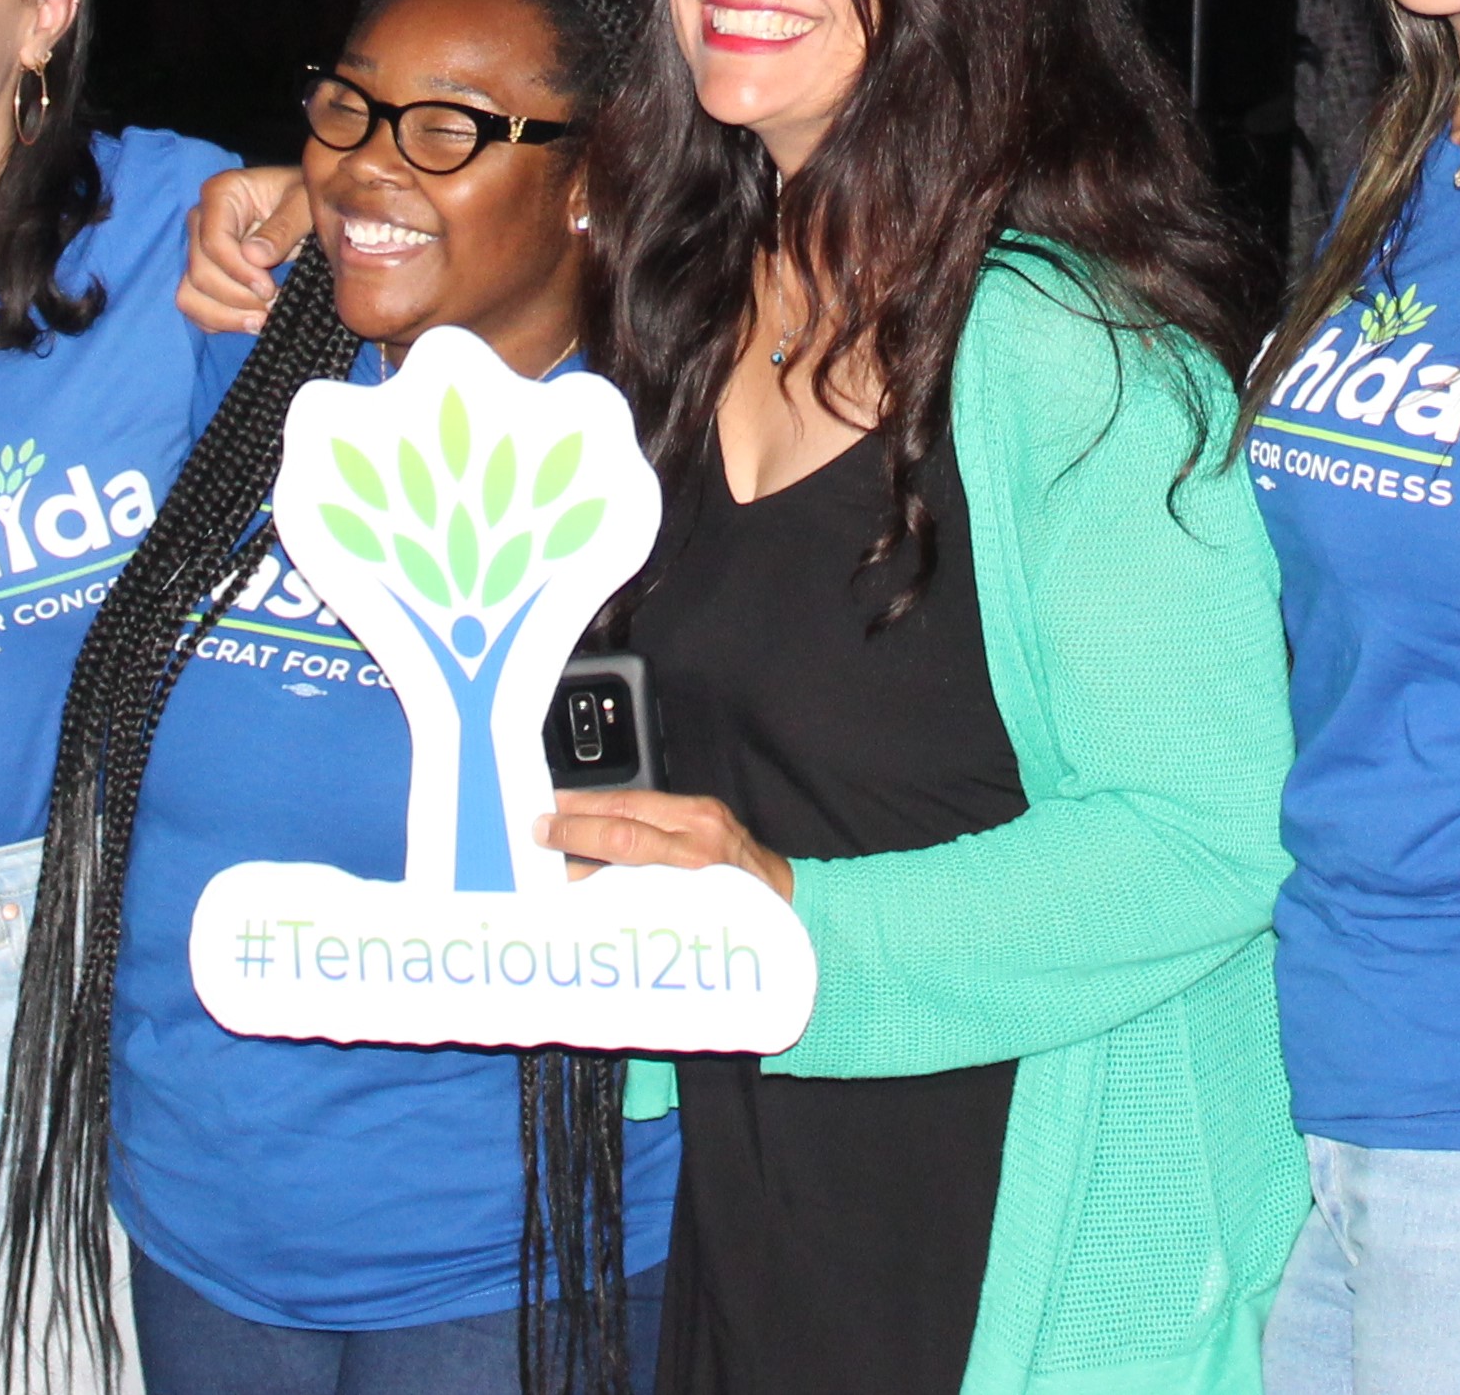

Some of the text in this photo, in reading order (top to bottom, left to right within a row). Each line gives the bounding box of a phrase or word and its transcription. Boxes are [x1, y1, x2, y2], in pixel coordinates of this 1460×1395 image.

[1249, 439, 1453, 507] FOR CONGRESS
[13, 577, 118, 626] CONG
[175, 633, 279, 669] CRAT
[282, 650, 351, 682] FOR
[235, 920, 762, 992] #Tenacious12th
